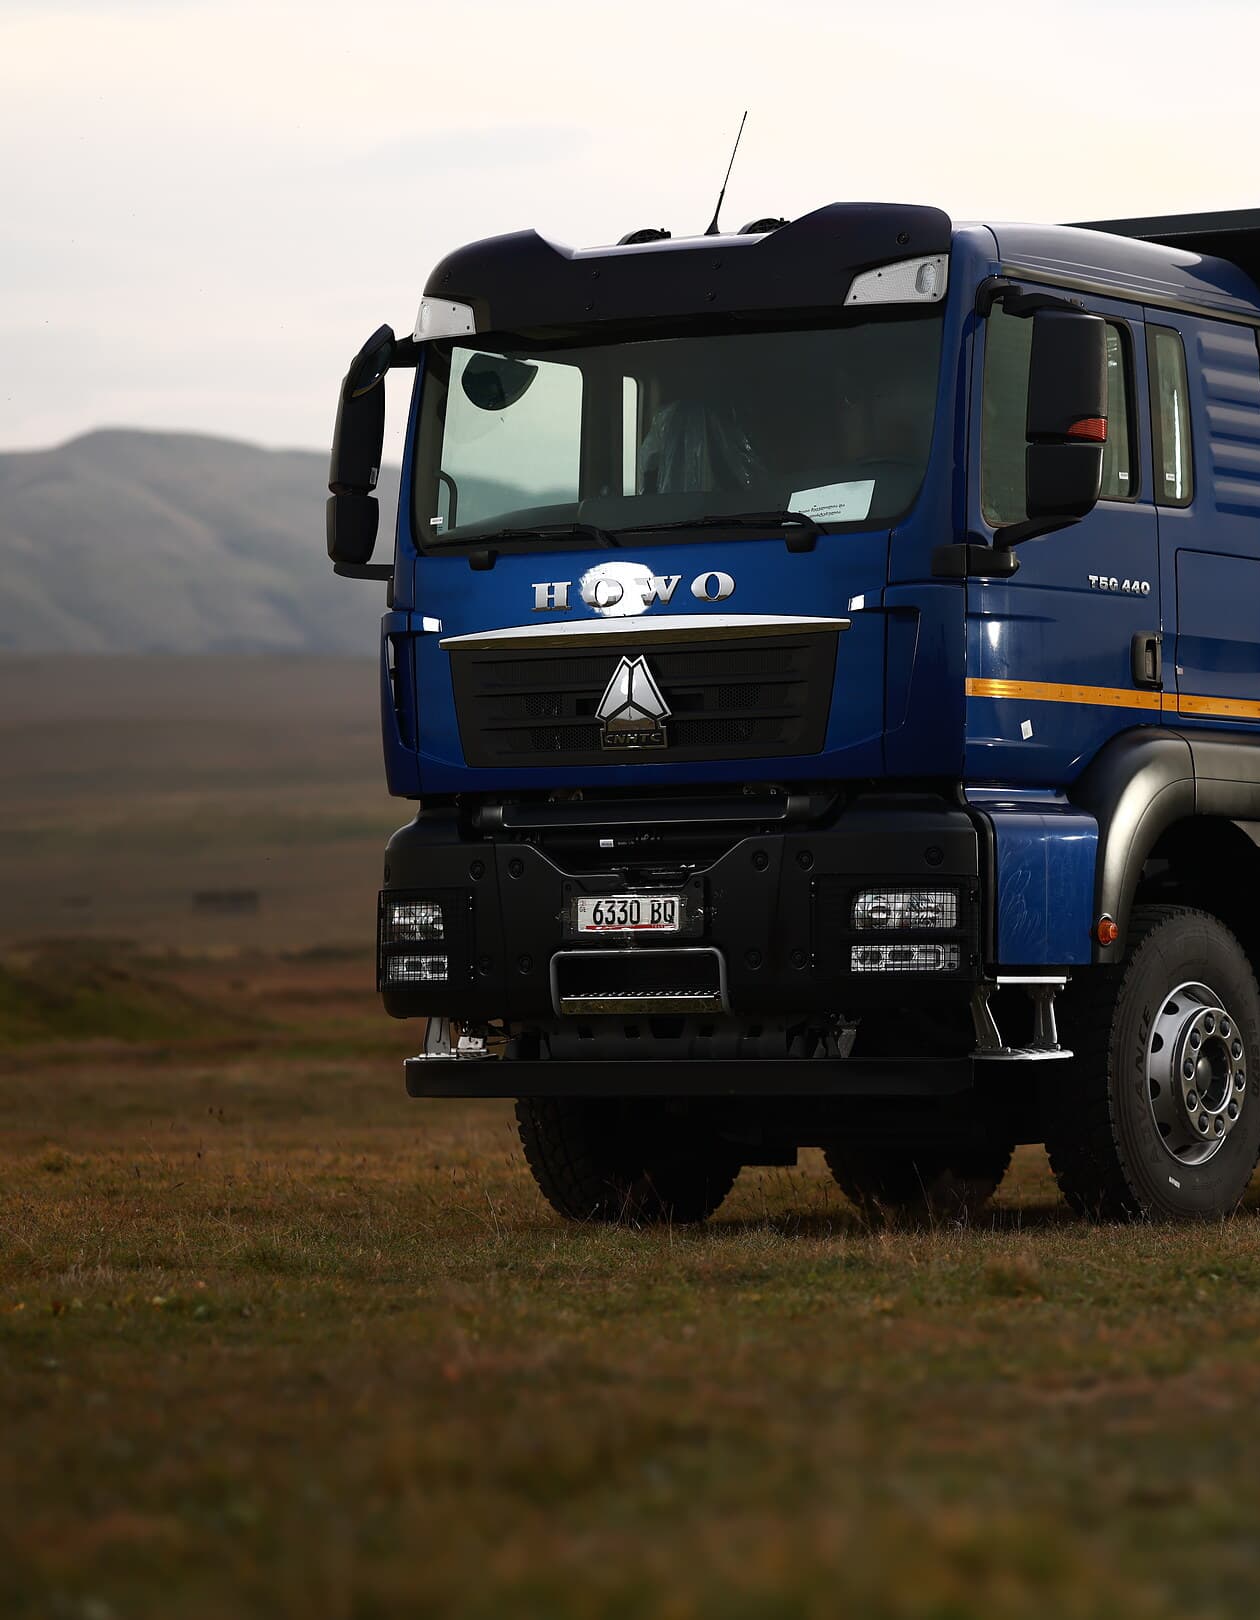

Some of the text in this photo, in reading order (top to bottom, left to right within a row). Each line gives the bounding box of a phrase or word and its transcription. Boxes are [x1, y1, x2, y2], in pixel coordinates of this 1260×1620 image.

[531, 571, 735, 612] HOWO
[1088, 574, 1150, 595] T5G 440
[593, 900, 675, 925] 6330 BQ
